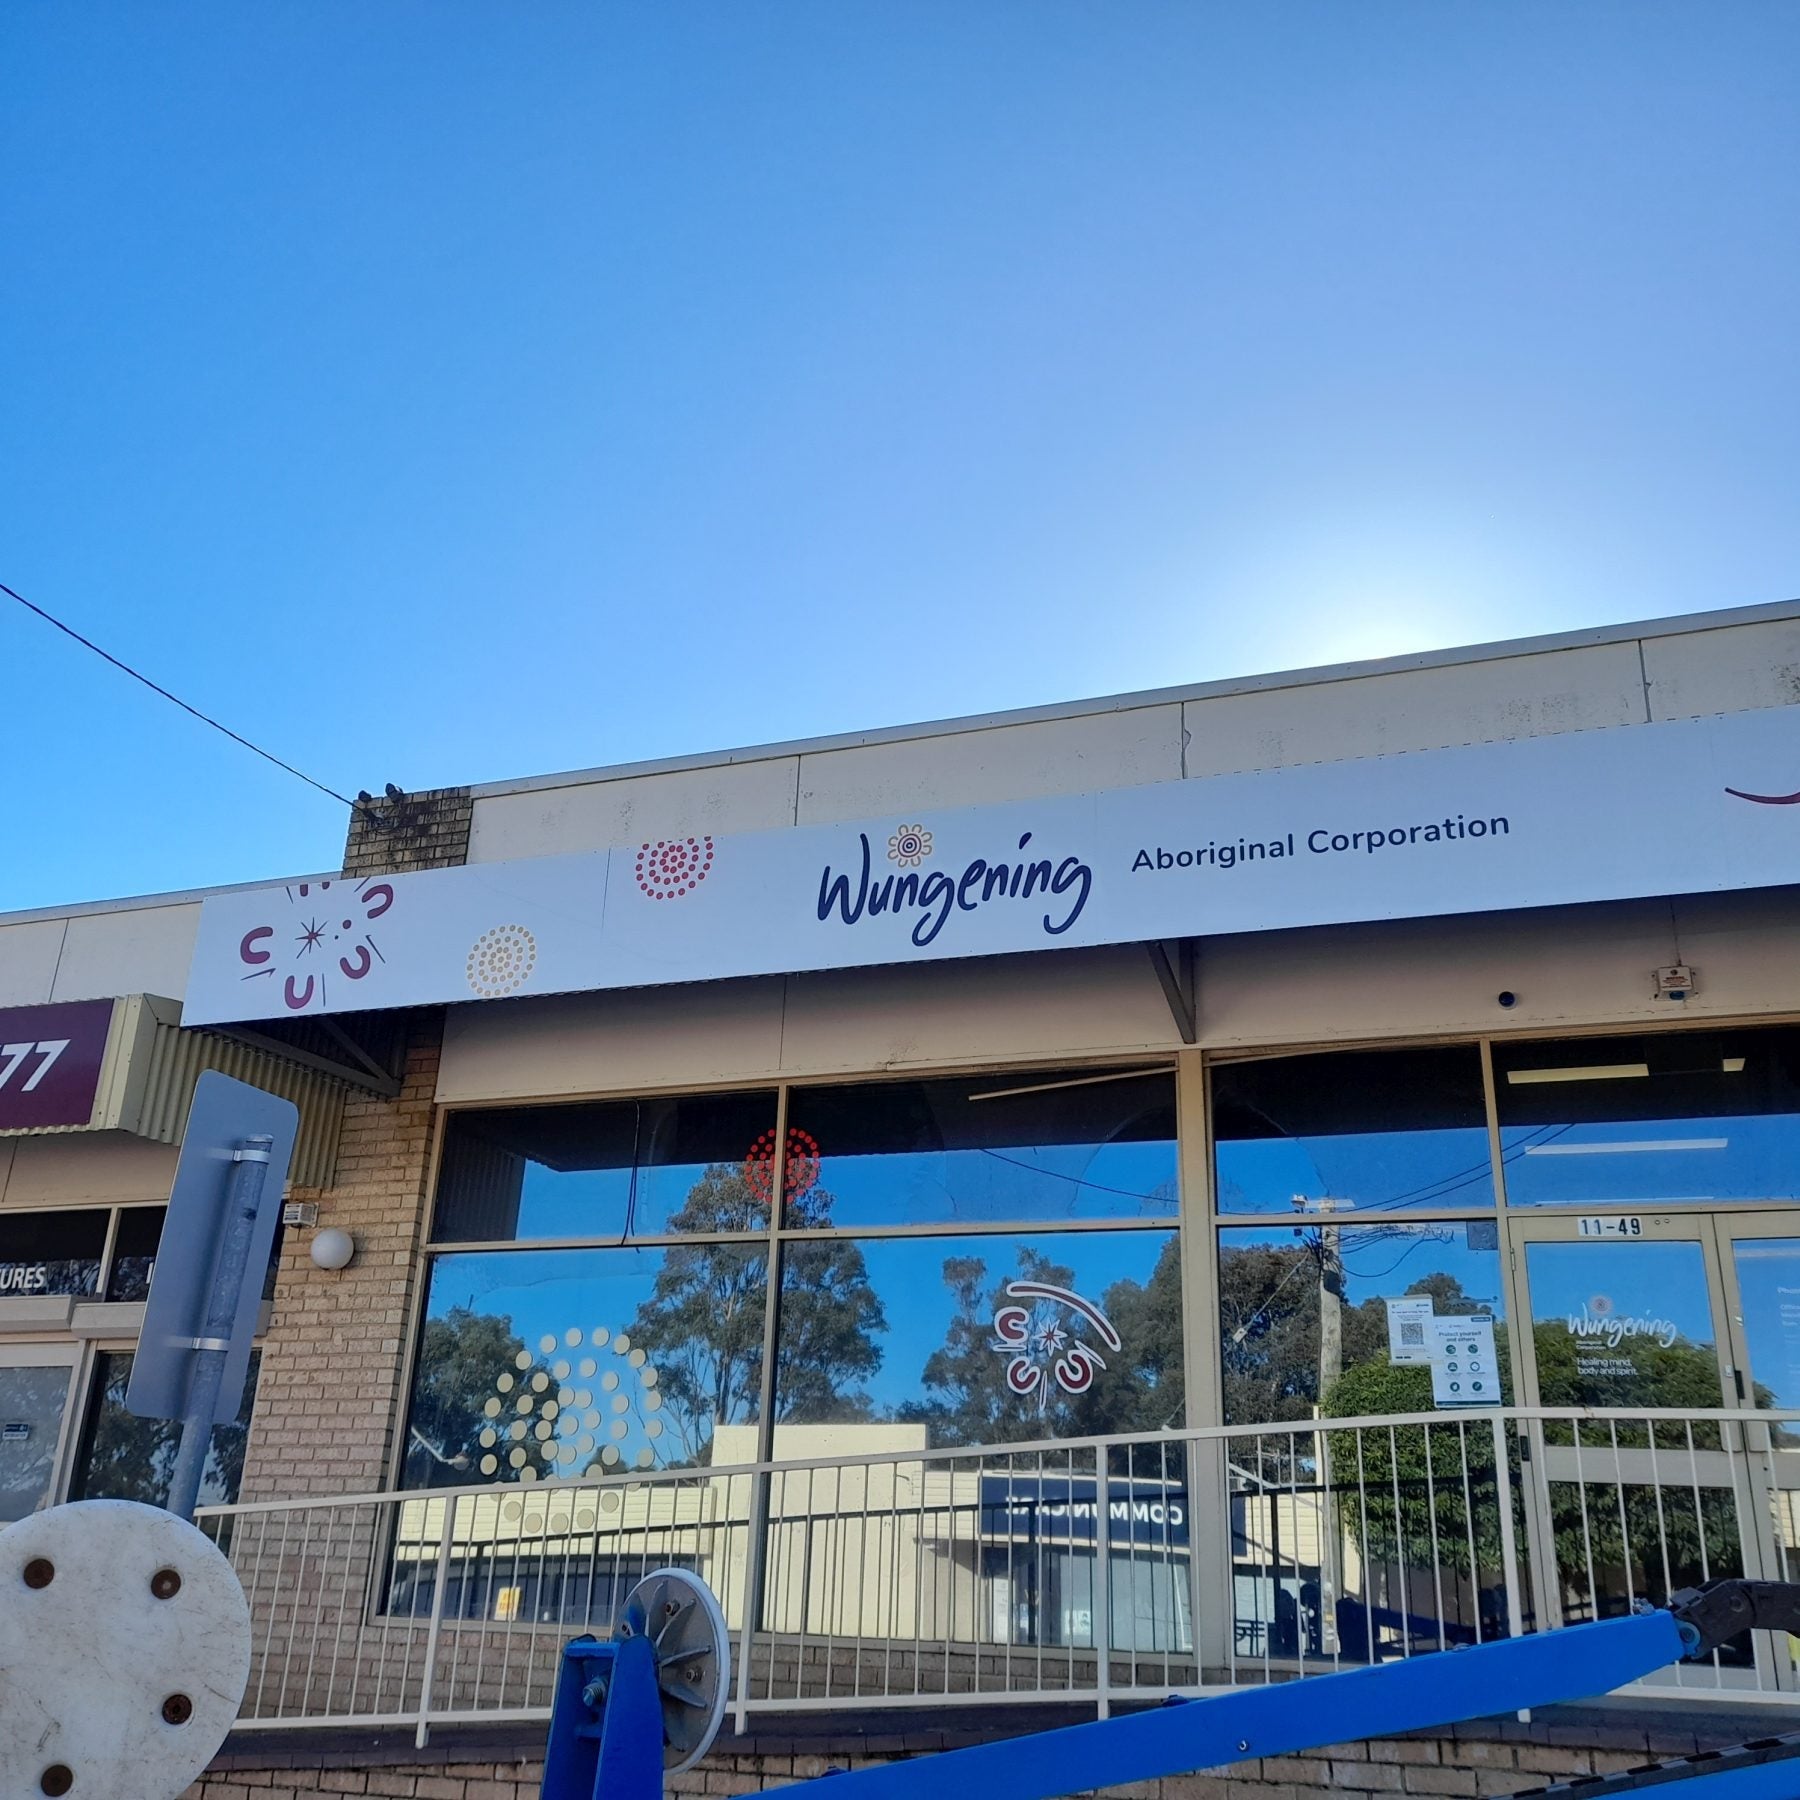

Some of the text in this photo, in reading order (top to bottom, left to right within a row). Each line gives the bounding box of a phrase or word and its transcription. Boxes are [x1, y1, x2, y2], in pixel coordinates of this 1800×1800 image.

[1131, 814, 1510, 872] Aboriginal Corporation
[817, 832, 1092, 947] Wungening
[1581, 1218, 1641, 1235] 11-49
[0, 1266, 47, 1290] URES
[1567, 1302, 1677, 1349] Wungening
[1577, 1357, 1608, 1368] Healing
[1578, 1367, 1599, 1376] body
[1600, 1367, 1615, 1375] and
